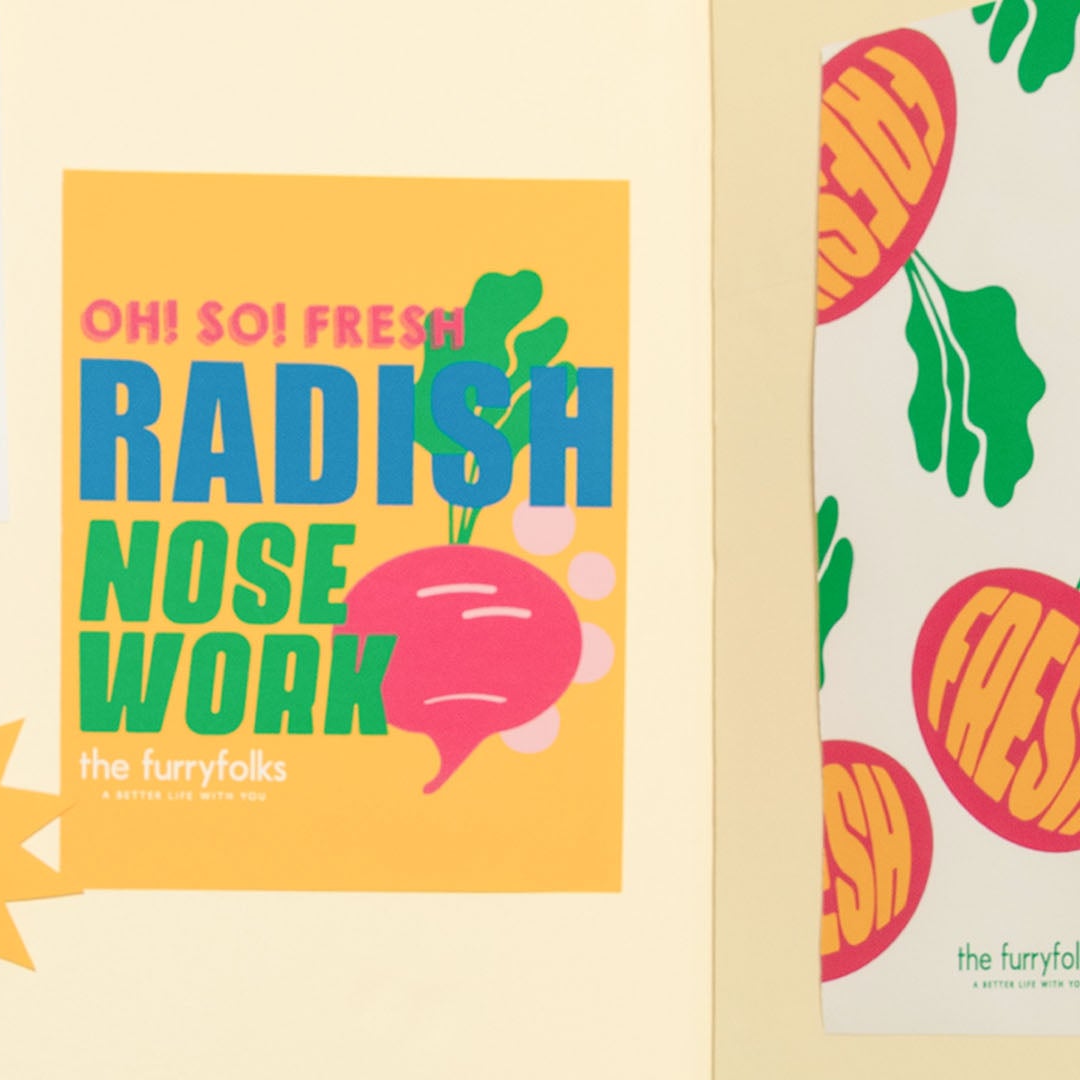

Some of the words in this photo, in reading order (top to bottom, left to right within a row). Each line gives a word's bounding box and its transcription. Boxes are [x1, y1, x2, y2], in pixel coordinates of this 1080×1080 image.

[80, 298, 179, 346] OH!
[196, 300, 288, 348] SO!
[303, 304, 466, 351] FRESH
[80, 357, 614, 509] RADISH
[79, 519, 357, 625] NOSE
[78, 631, 399, 735] WORK
[79, 746, 130, 781] the
[142, 747, 288, 788] furryfolks
[101, 791, 111, 801] A
[115, 790, 162, 801] BETTER
[167, 790, 194, 801] LIFE
[200, 791, 235, 801] WITH
[240, 791, 267, 802] YOU
[957, 941, 992, 971] the
[982, 980, 1015, 989] BETTER
